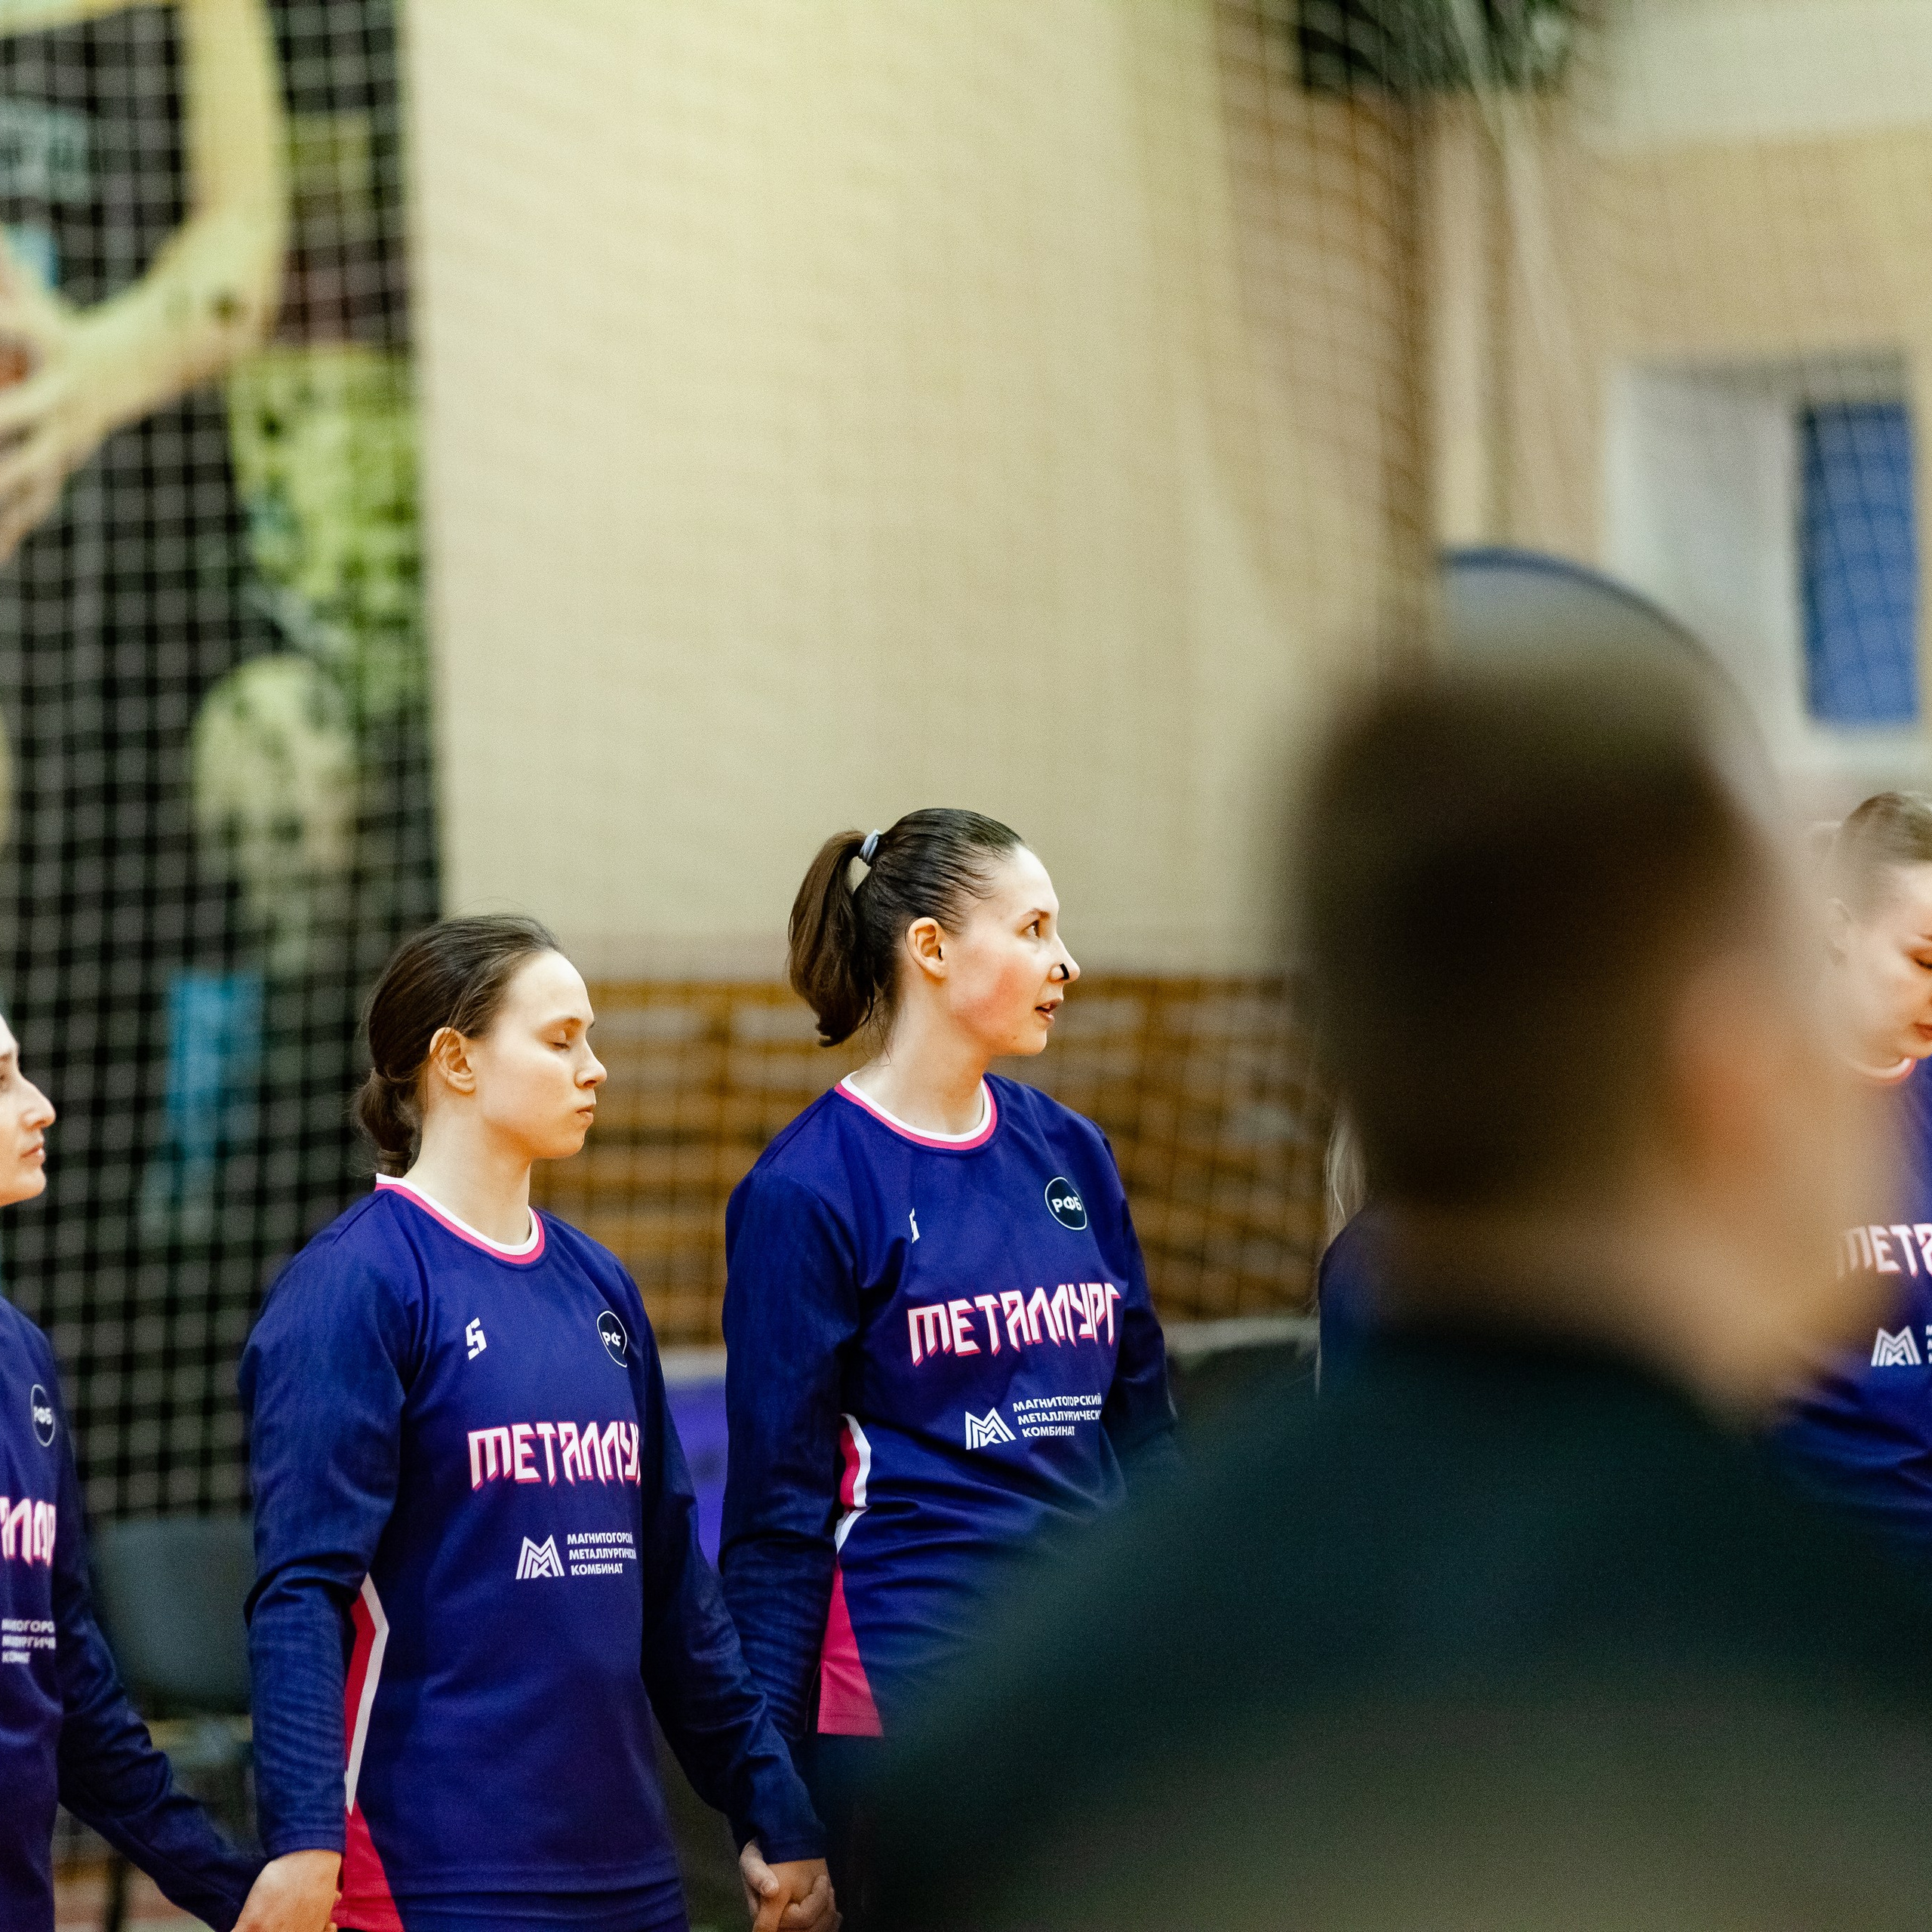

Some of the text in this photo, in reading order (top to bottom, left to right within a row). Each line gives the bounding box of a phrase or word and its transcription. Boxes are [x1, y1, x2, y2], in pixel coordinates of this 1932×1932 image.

[1051, 1195, 1082, 1213] РФБ
[907, 1282, 1121, 1367] МЕТАЛЛУРГ
[1012, 1392, 1102, 1412] МАГНИТОГОРСКИЙ
[1017, 1409, 1101, 1426] МЕТАЛЛУРГИЧЕСК
[1022, 1426, 1075, 1438] КОМБИНАТ
[467, 1421, 641, 1491] МЕТАЛЛУ
[571, 1563, 623, 1576] КОМБИНАТ
